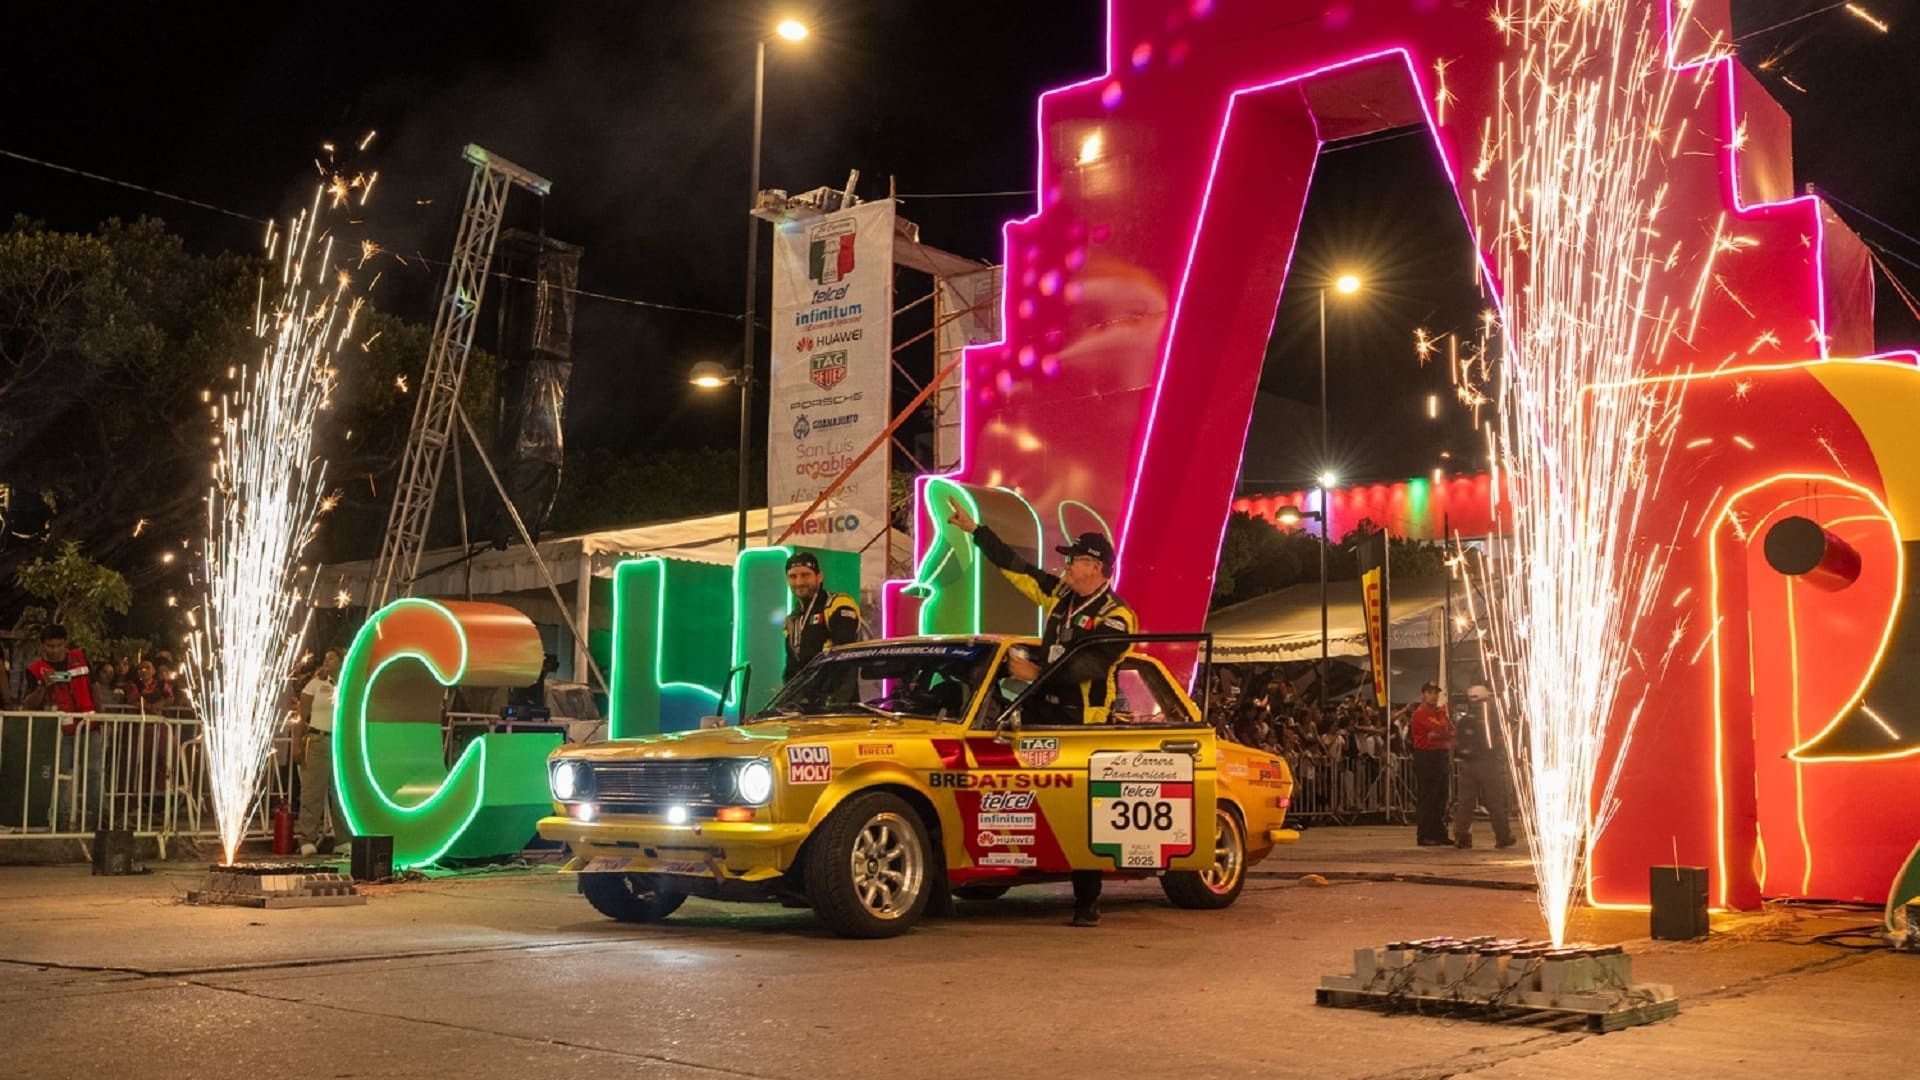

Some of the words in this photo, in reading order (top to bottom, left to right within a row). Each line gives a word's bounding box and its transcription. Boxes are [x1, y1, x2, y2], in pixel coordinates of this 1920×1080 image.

[811, 283, 850, 305] telcel
[795, 304, 862, 326] infinitum
[816, 329, 863, 346] HUAWEI
[813, 353, 843, 369] TAG
[790, 392, 864, 410] PORSCHE
[796, 443, 823, 459] San
[827, 437, 854, 455] Luis
[1023, 739, 1056, 749] TAG
[789, 746, 829, 764] LIQUI
[1021, 750, 1056, 768] HEUER
[791, 764, 831, 782] MOLY
[981, 790, 1035, 810] telcel
[1122, 785, 1158, 797] telcel
[980, 814, 1034, 823] infinitum
[1110, 801, 1173, 831] 308
[996, 836, 1033, 845] HUAWEI
[1128, 856, 1154, 866] 2025
